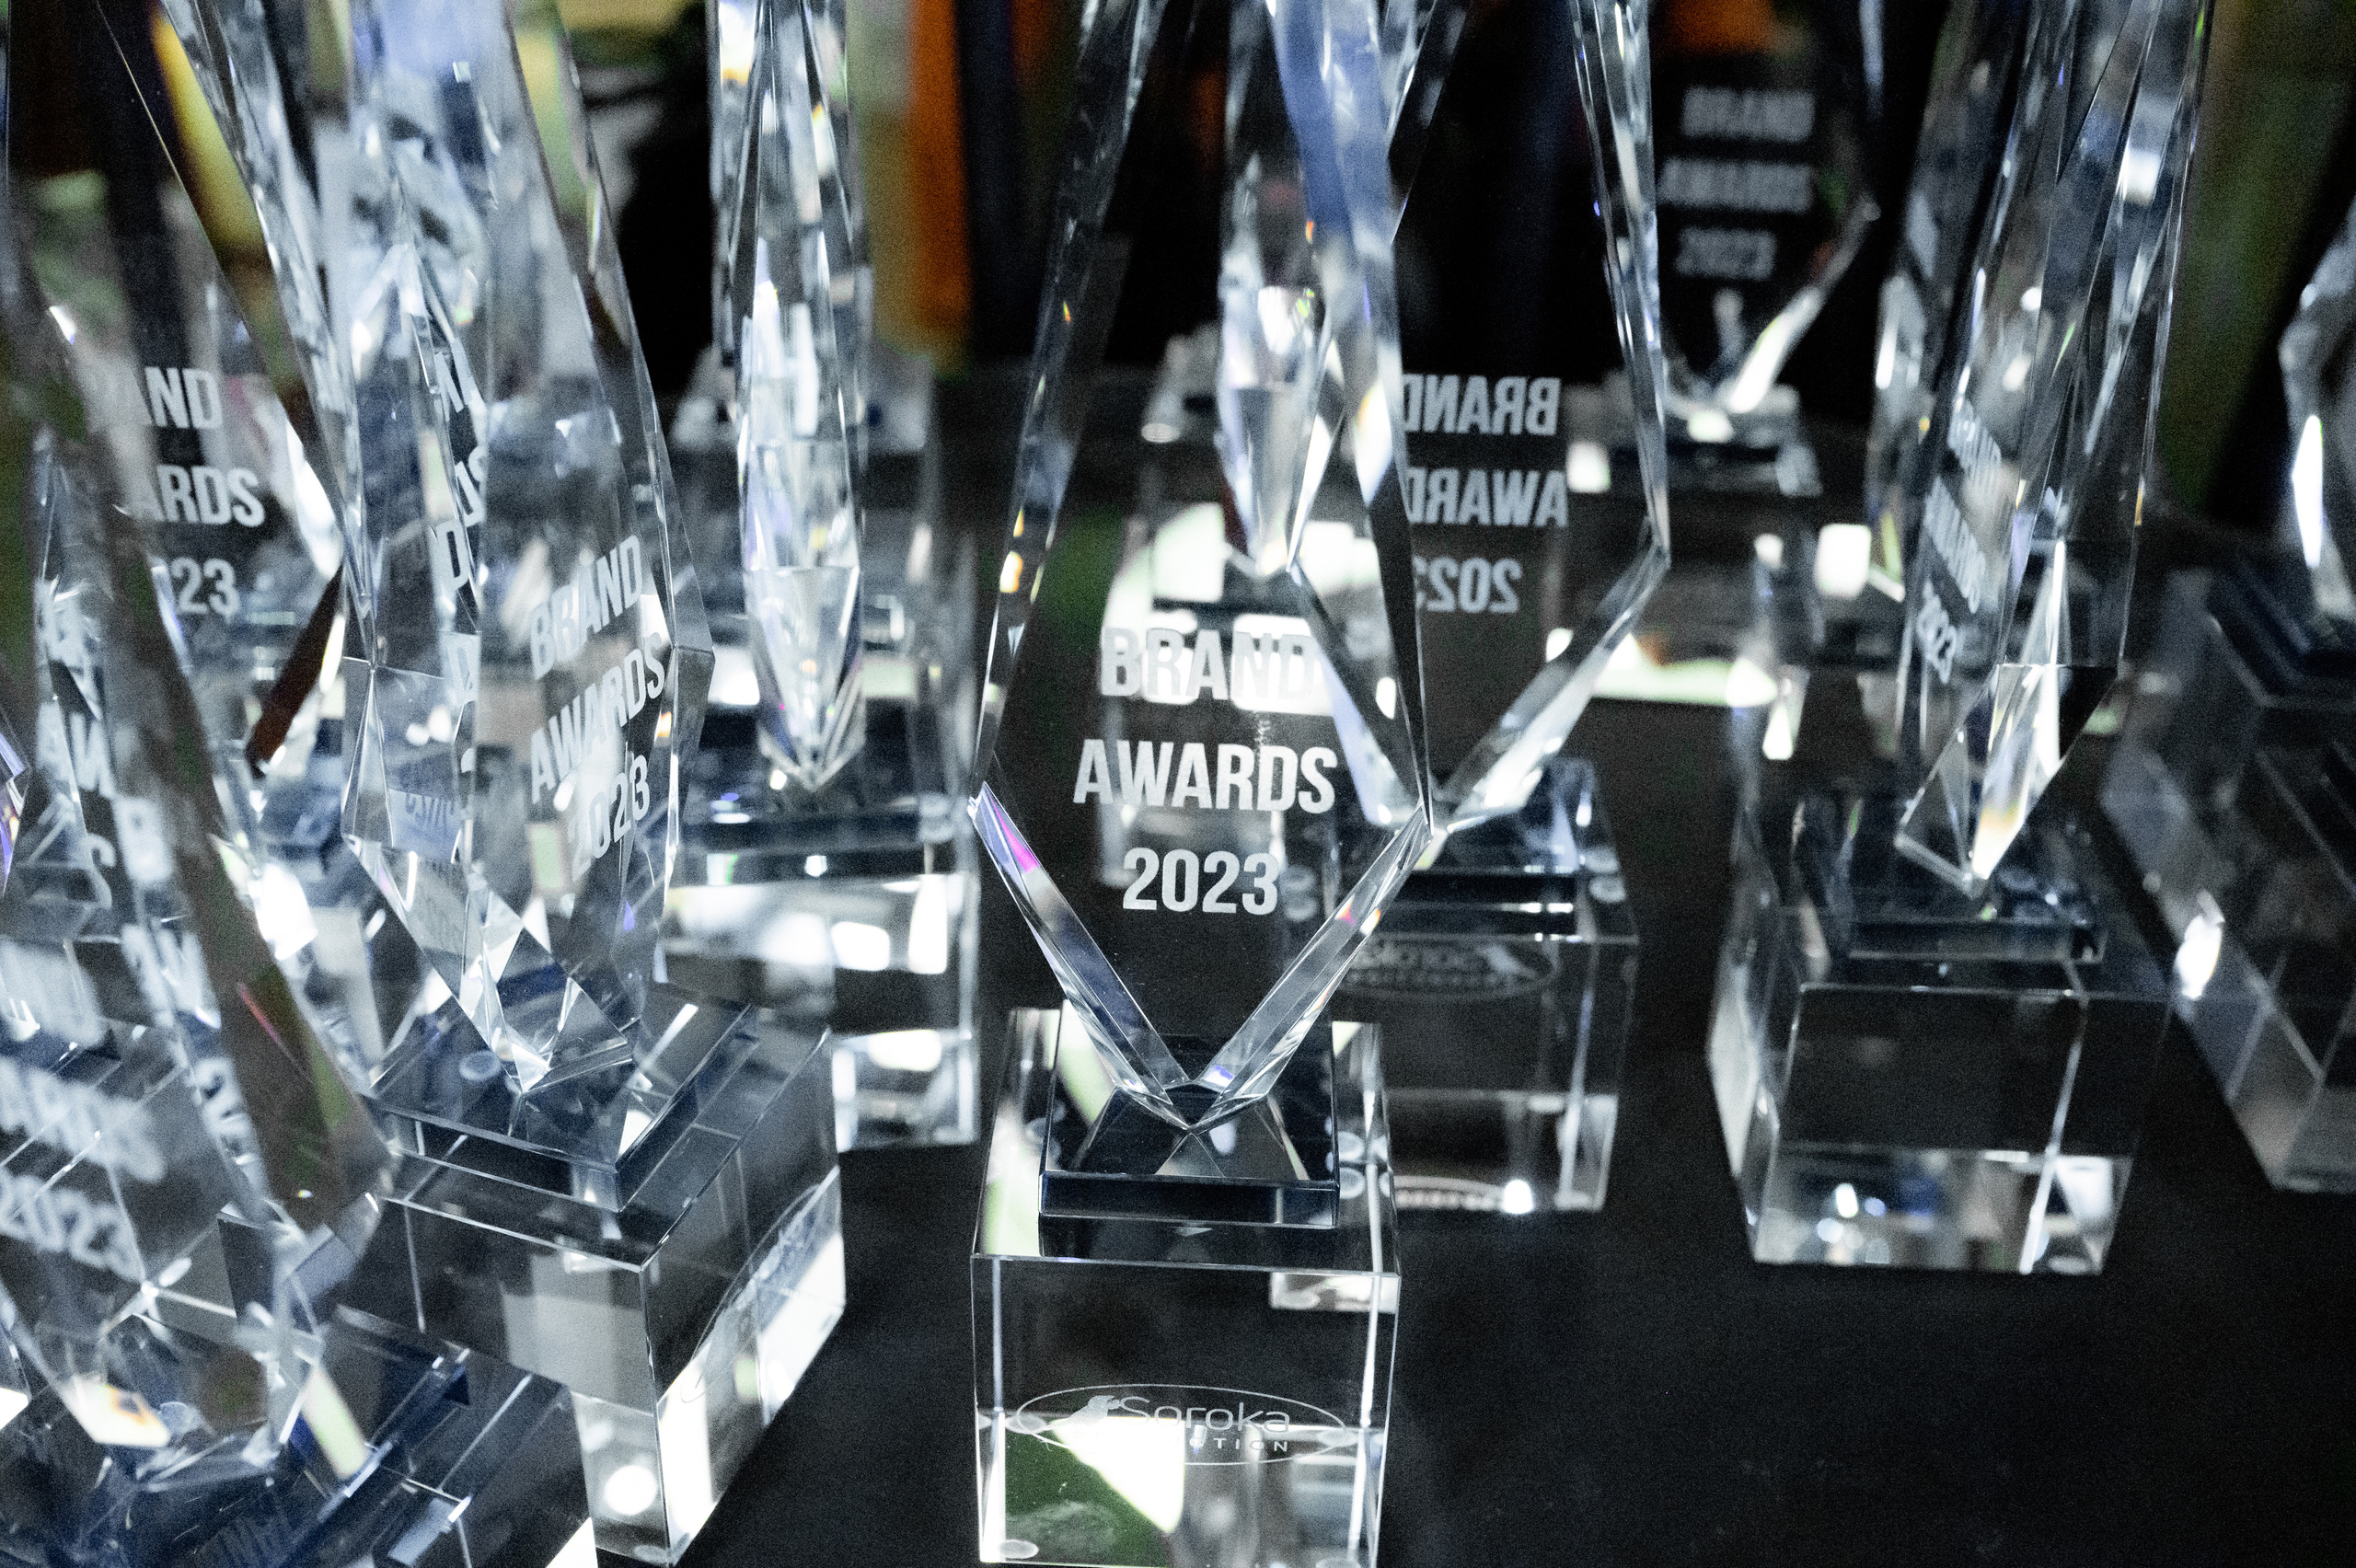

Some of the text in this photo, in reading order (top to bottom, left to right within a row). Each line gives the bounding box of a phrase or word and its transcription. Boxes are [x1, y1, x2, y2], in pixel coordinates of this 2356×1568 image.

[530, 534, 642, 682] BRAND
[1101, 627, 1322, 703] BRAND
[531, 631, 664, 805] AWARDS
[1072, 738, 1339, 815] AWARDS
[1122, 847, 1281, 917] 2023
[1118, 1395, 1290, 1433] Soroka
